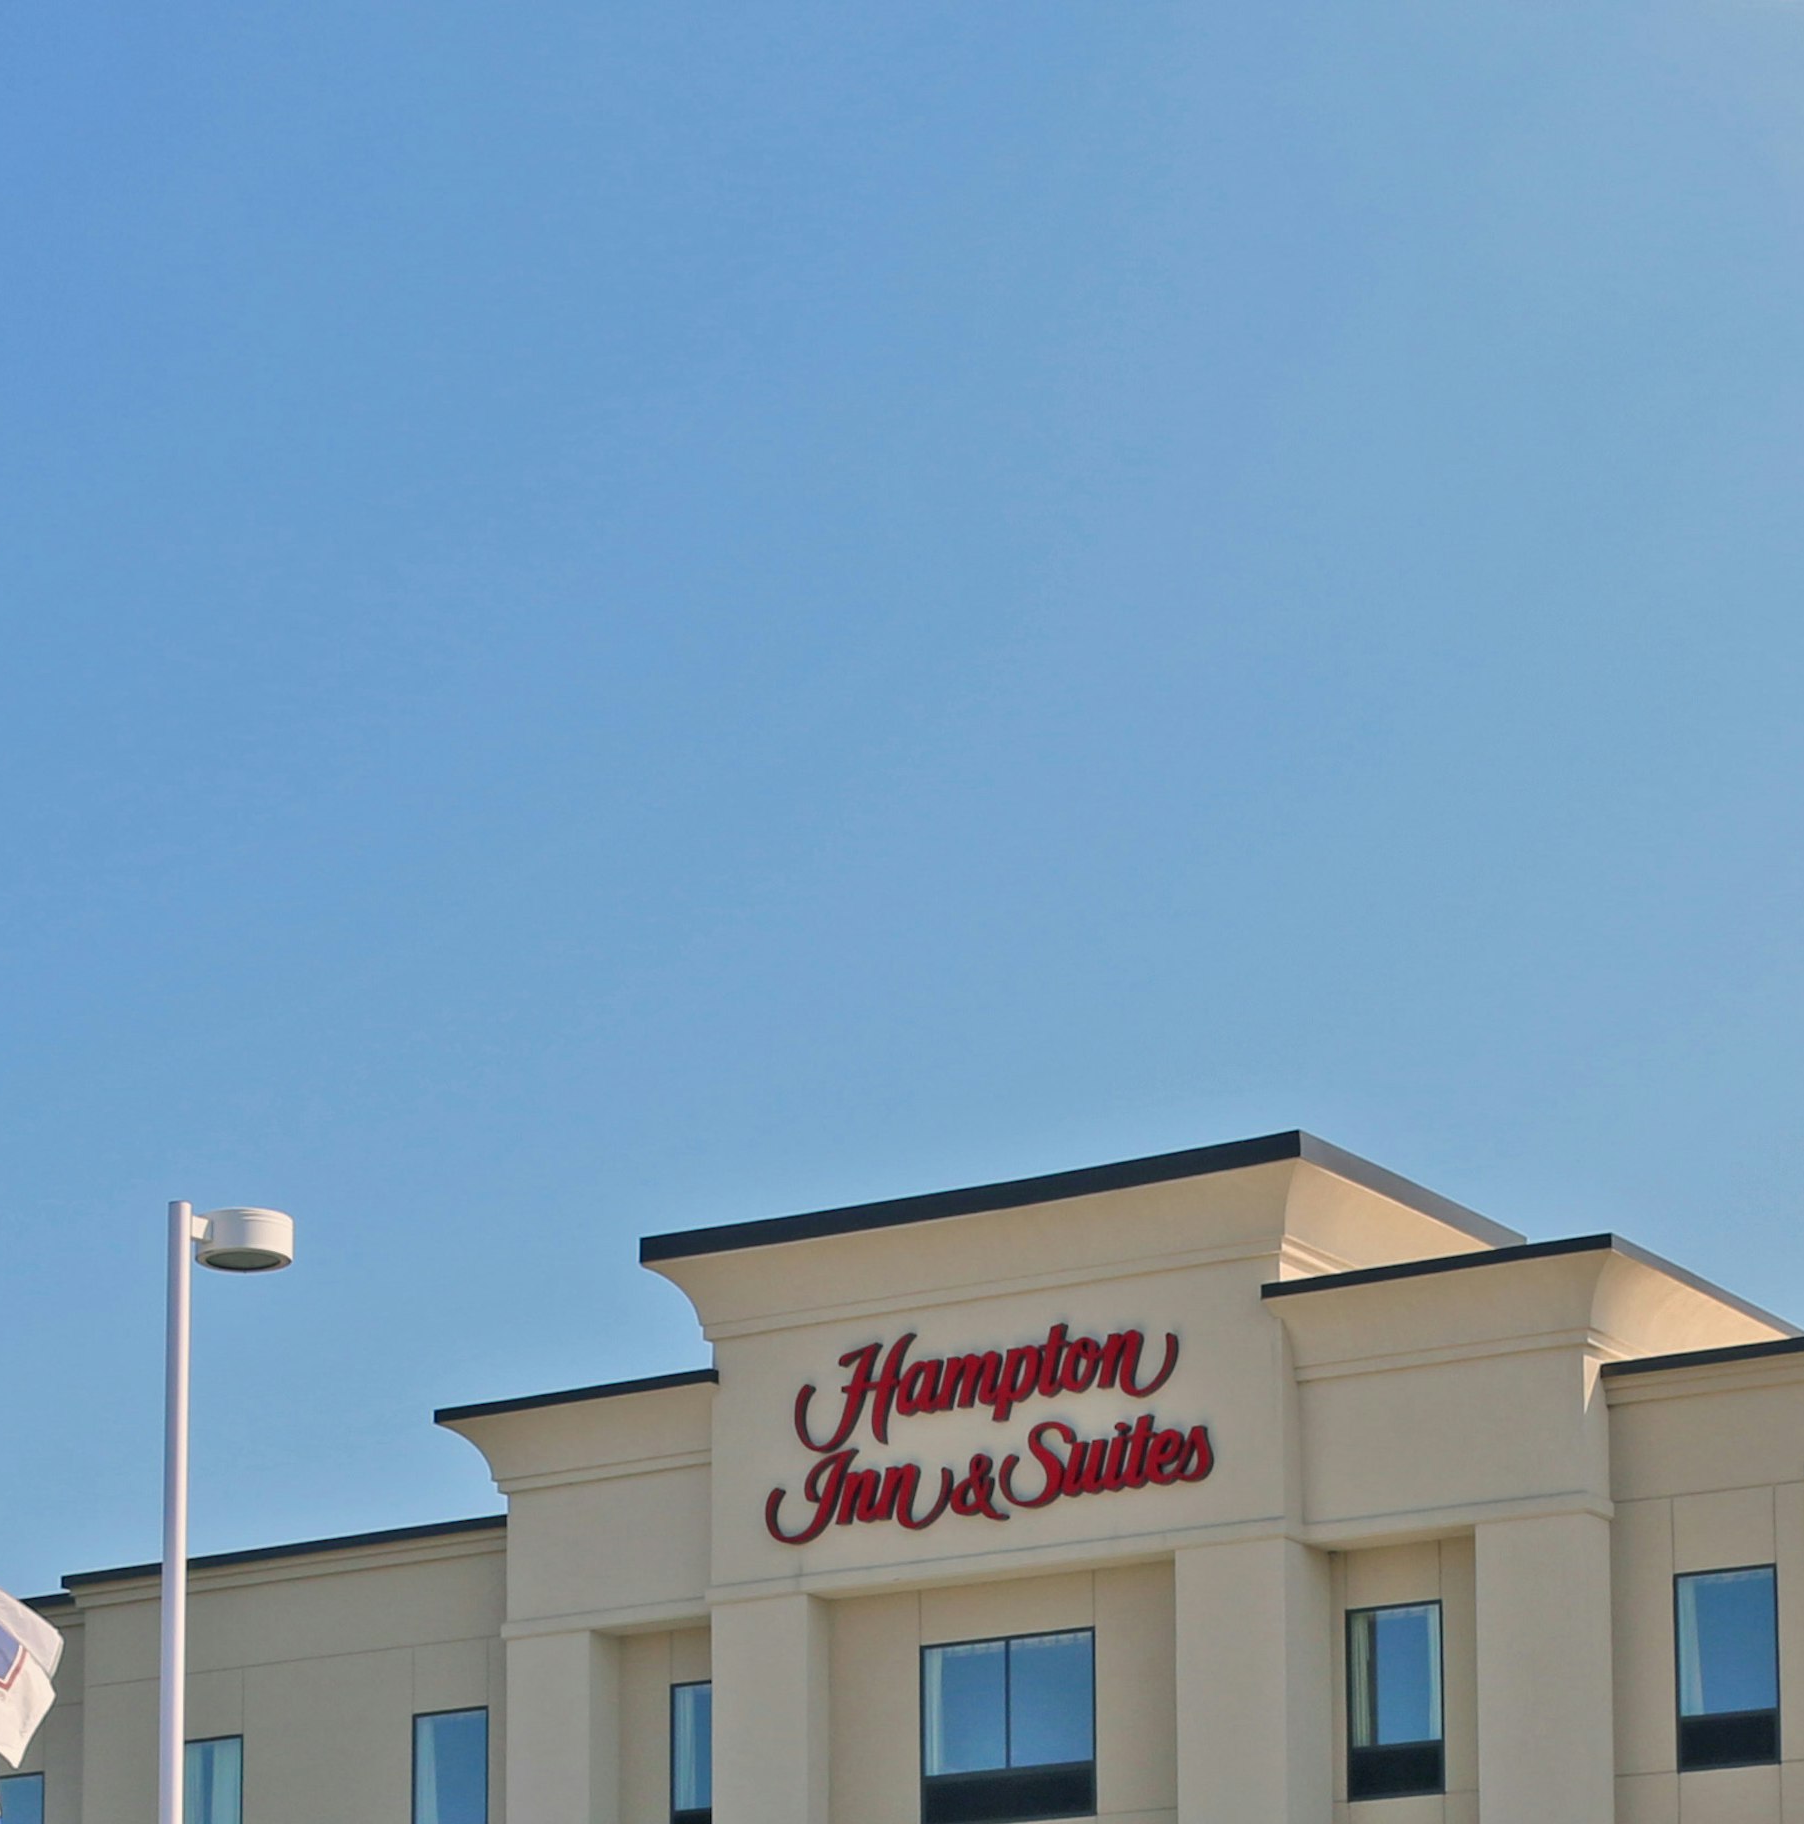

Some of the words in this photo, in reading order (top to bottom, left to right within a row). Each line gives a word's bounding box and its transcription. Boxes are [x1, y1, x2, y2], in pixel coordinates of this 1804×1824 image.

[795, 1323, 1179, 1452] Hampton
[765, 1449, 953, 1544] Inn
[950, 1453, 1010, 1520] &
[999, 1414, 1214, 1508] Suites
